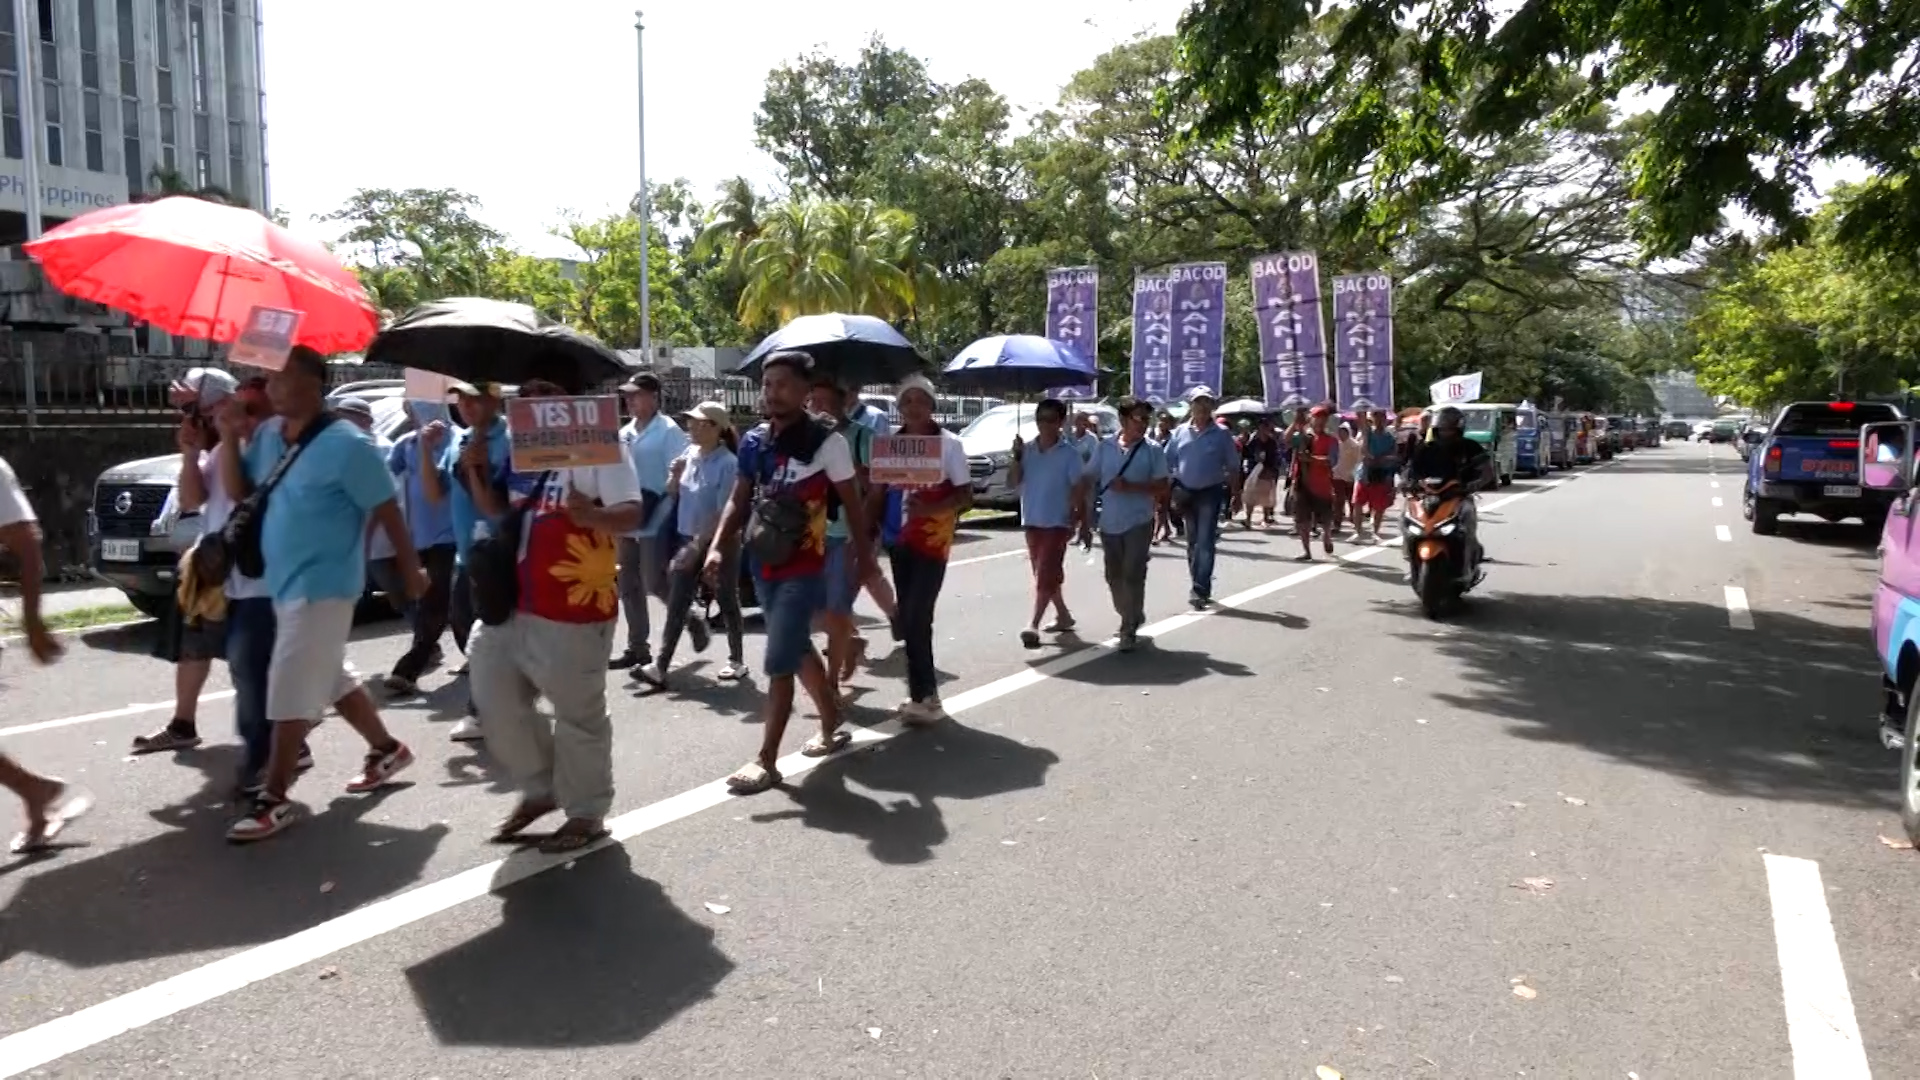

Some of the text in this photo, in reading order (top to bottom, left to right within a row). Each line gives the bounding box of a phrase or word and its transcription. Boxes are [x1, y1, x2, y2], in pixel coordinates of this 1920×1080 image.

[0, 175, 115, 207] Phippines
[1172, 267, 1224, 282] BACOD
[1253, 255, 1313, 277] BACOD
[1049, 271, 1096, 288] BACOD
[1336, 276, 1388, 293] BACOD
[530, 400, 599, 428] YES TO
[890, 439, 926, 455] NO TO
